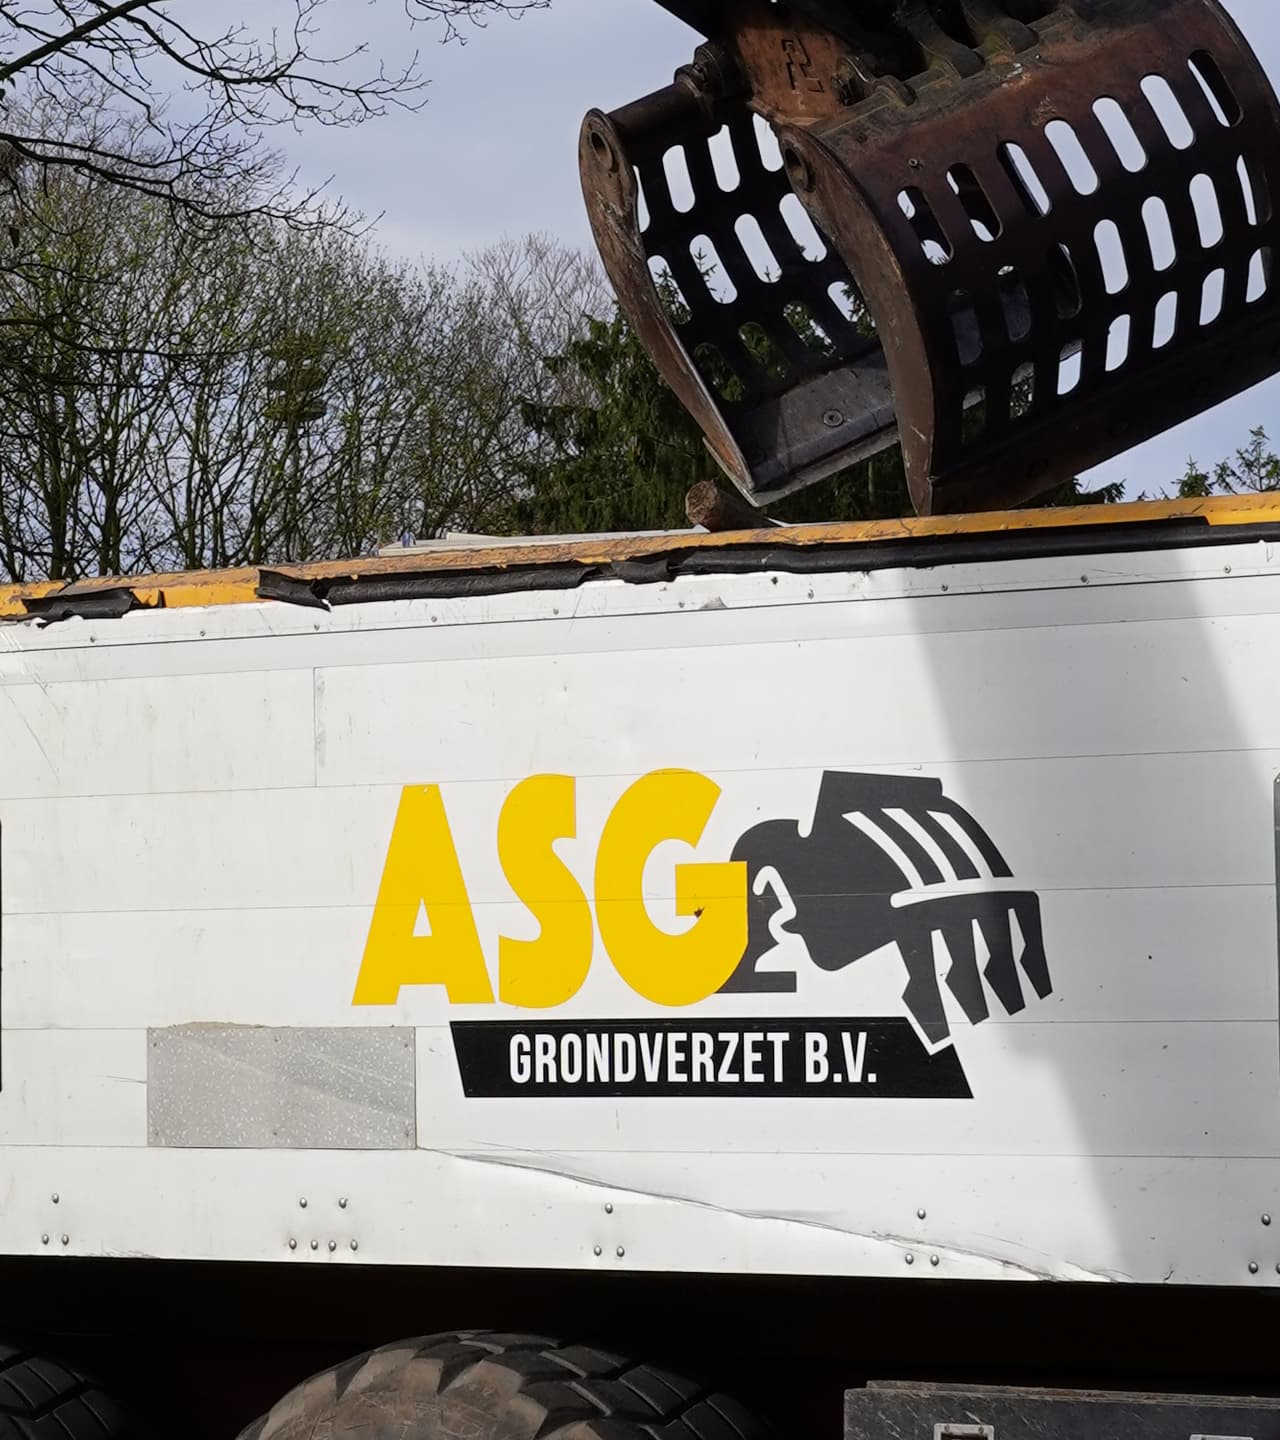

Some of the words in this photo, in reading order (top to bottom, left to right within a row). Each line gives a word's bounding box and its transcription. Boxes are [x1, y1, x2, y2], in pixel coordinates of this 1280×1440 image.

[351, 767, 749, 1009] ASG
[509, 1031, 790, 1085] GRONDVERZET
[804, 1031, 877, 1084] B.V.
